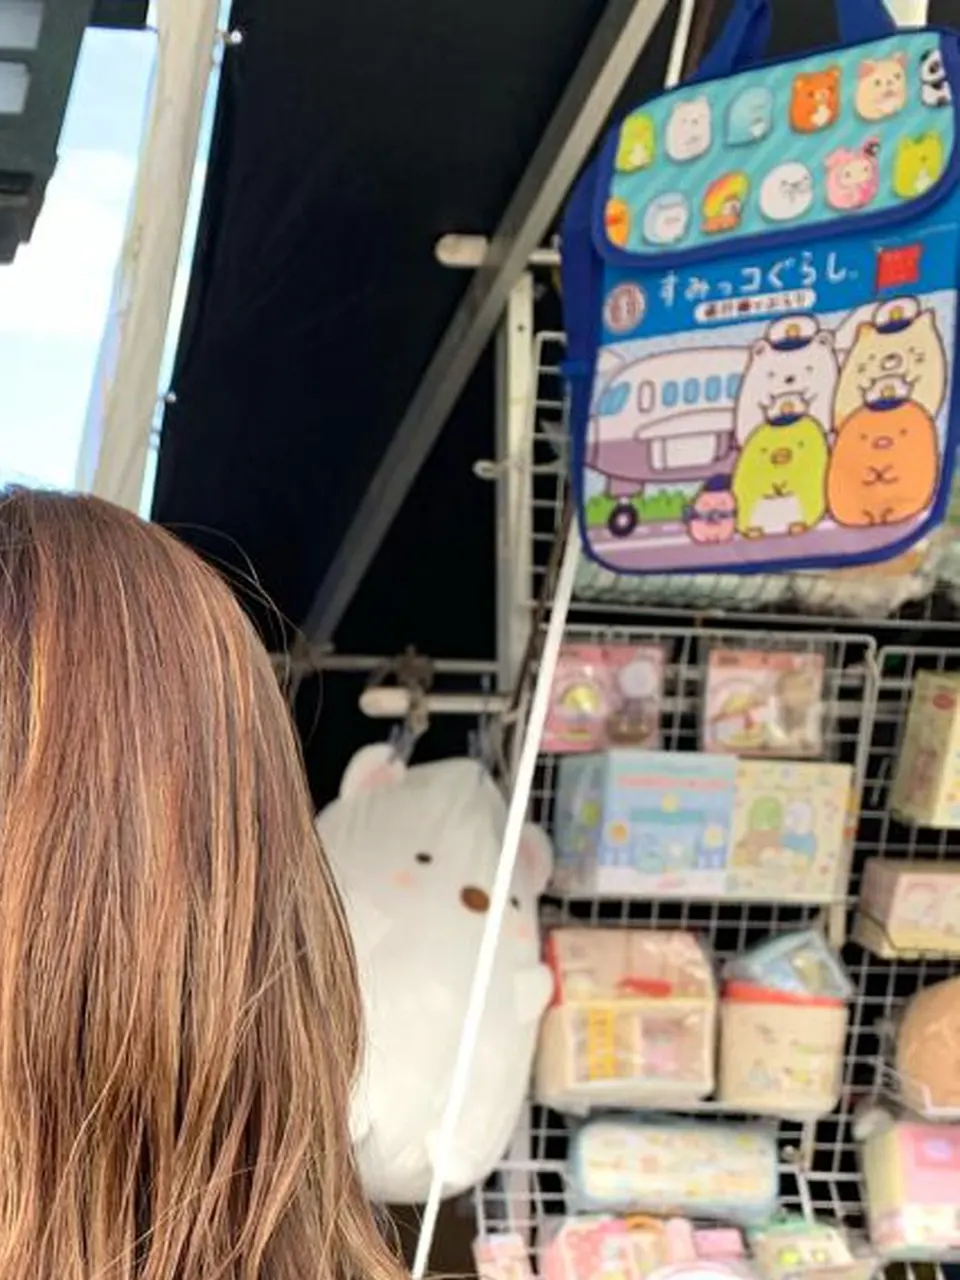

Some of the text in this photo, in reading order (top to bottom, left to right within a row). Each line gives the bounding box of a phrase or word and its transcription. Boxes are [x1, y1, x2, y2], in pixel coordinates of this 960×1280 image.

[660, 250, 847, 307] すみっコぐらし
